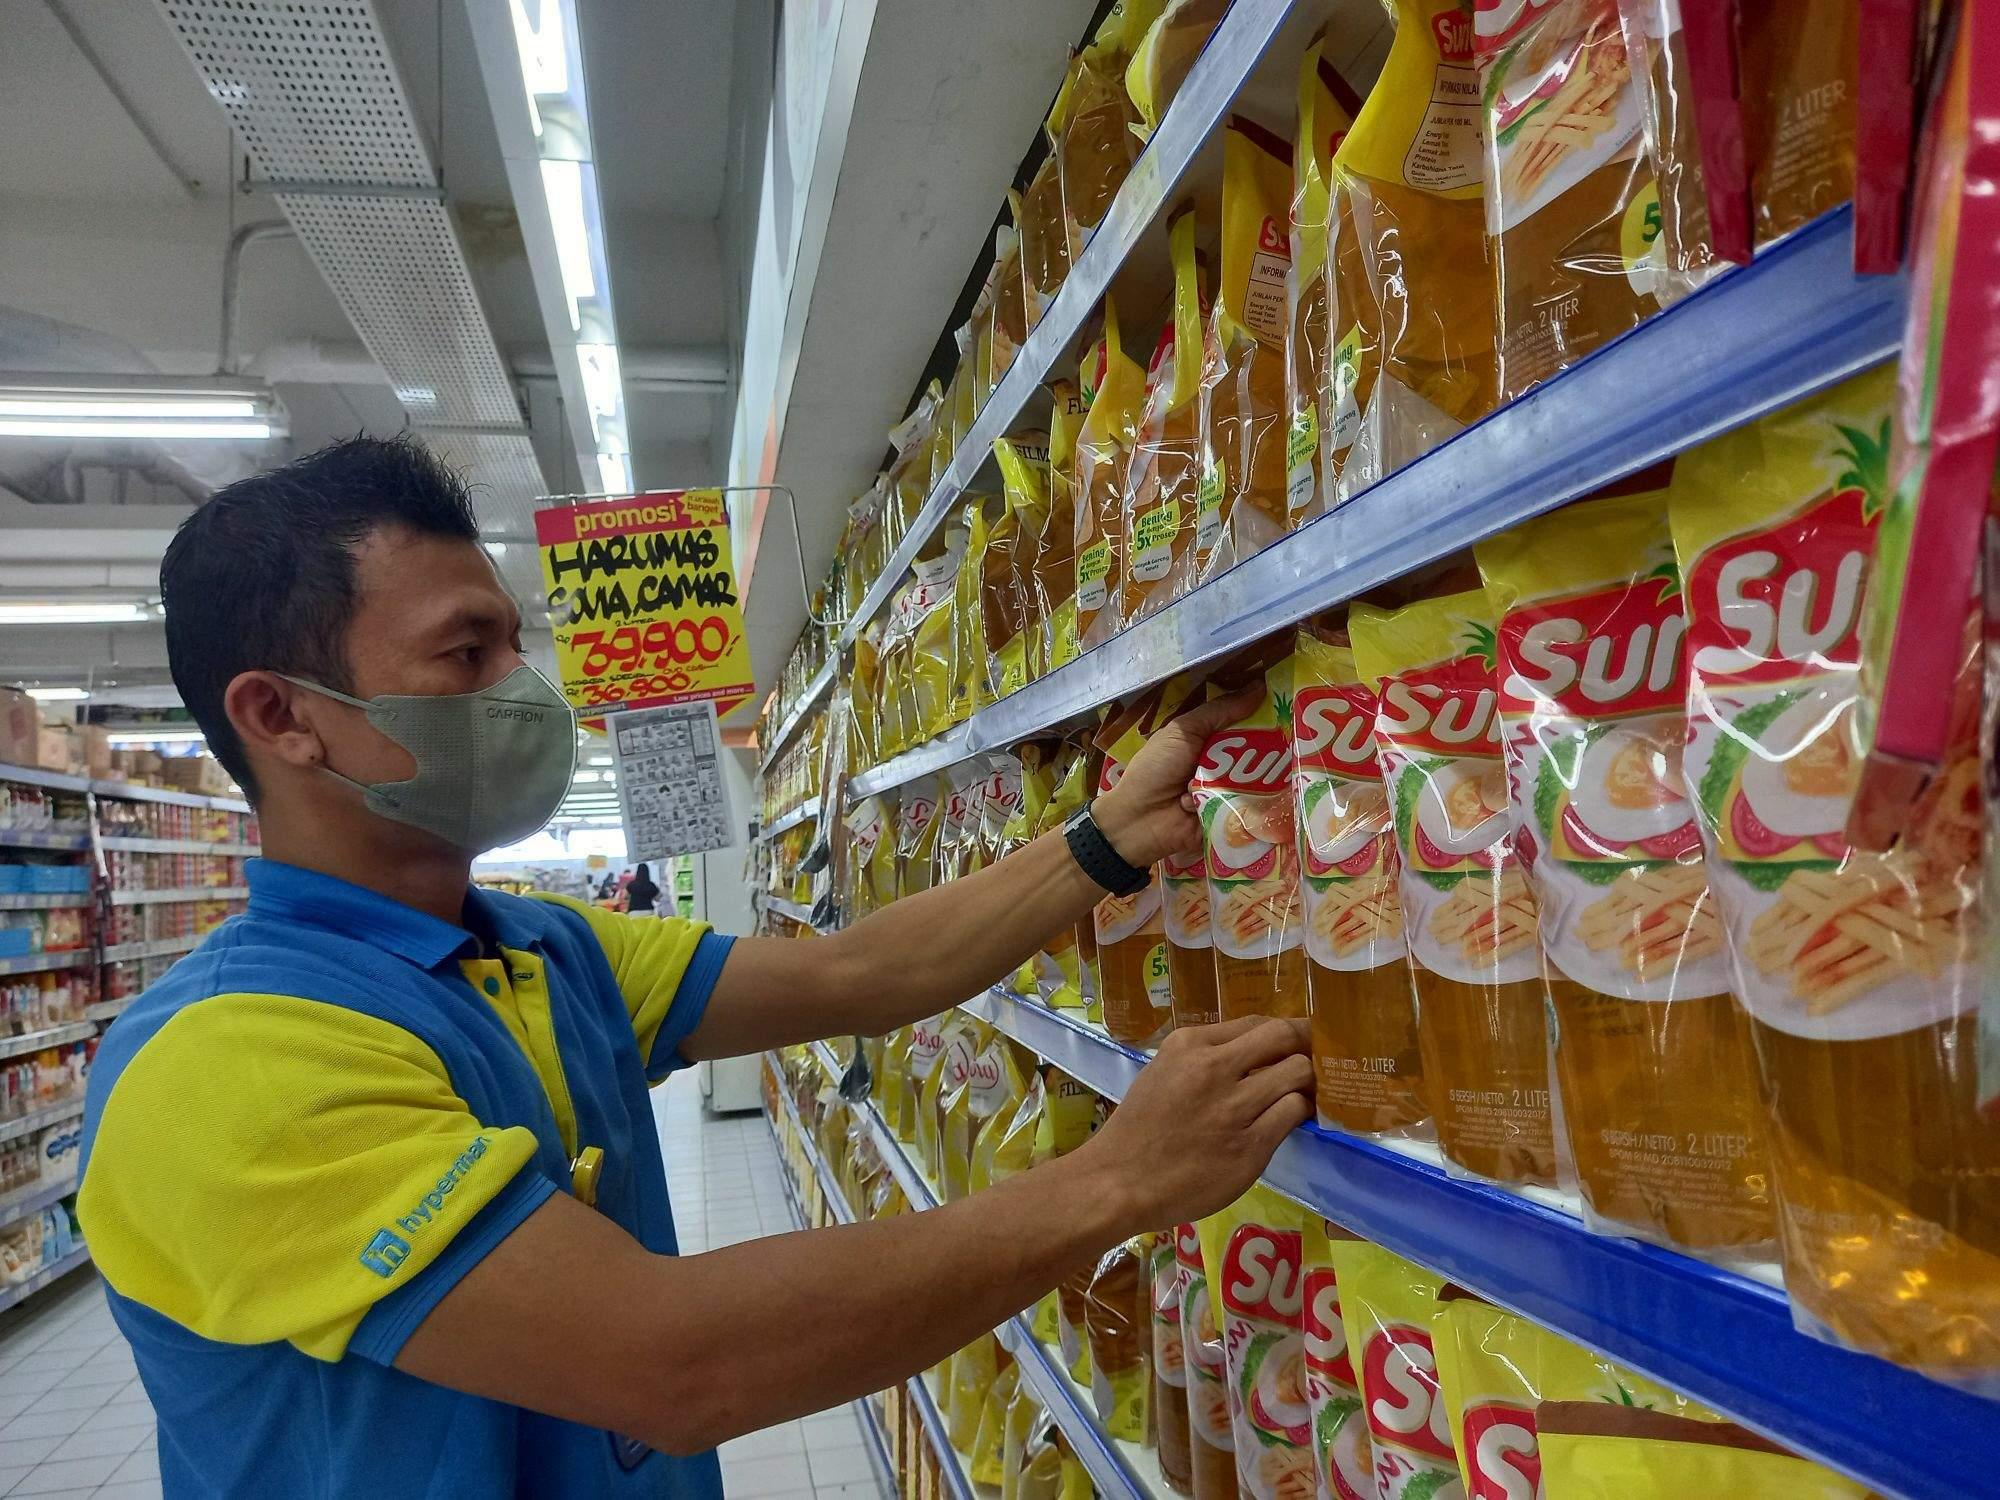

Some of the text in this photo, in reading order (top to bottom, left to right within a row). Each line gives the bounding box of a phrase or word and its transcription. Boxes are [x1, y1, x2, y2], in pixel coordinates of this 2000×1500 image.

[1540, 311, 1546, 328] 2
[1550, 297, 1580, 322] LITER
[573, 499, 678, 539] promosi
[1141, 510, 1173, 528] Bening
[1152, 530, 1176, 542] Proses
[549, 529, 719, 585] HARUMAS
[674, 694, 690, 703] Low
[690, 691, 711, 702] prices
[712, 688, 726, 697] and
[1362, 1057, 1369, 1072] 2
[1371, 1057, 1396, 1073] LITER
[1512, 1089, 1521, 1107] 2
[1525, 1089, 1549, 1108] LITE
[1645, 1135, 1676, 1152] NETTO
[1687, 1132, 1698, 1155] 2
[1704, 1135, 1748, 1158] LITER
